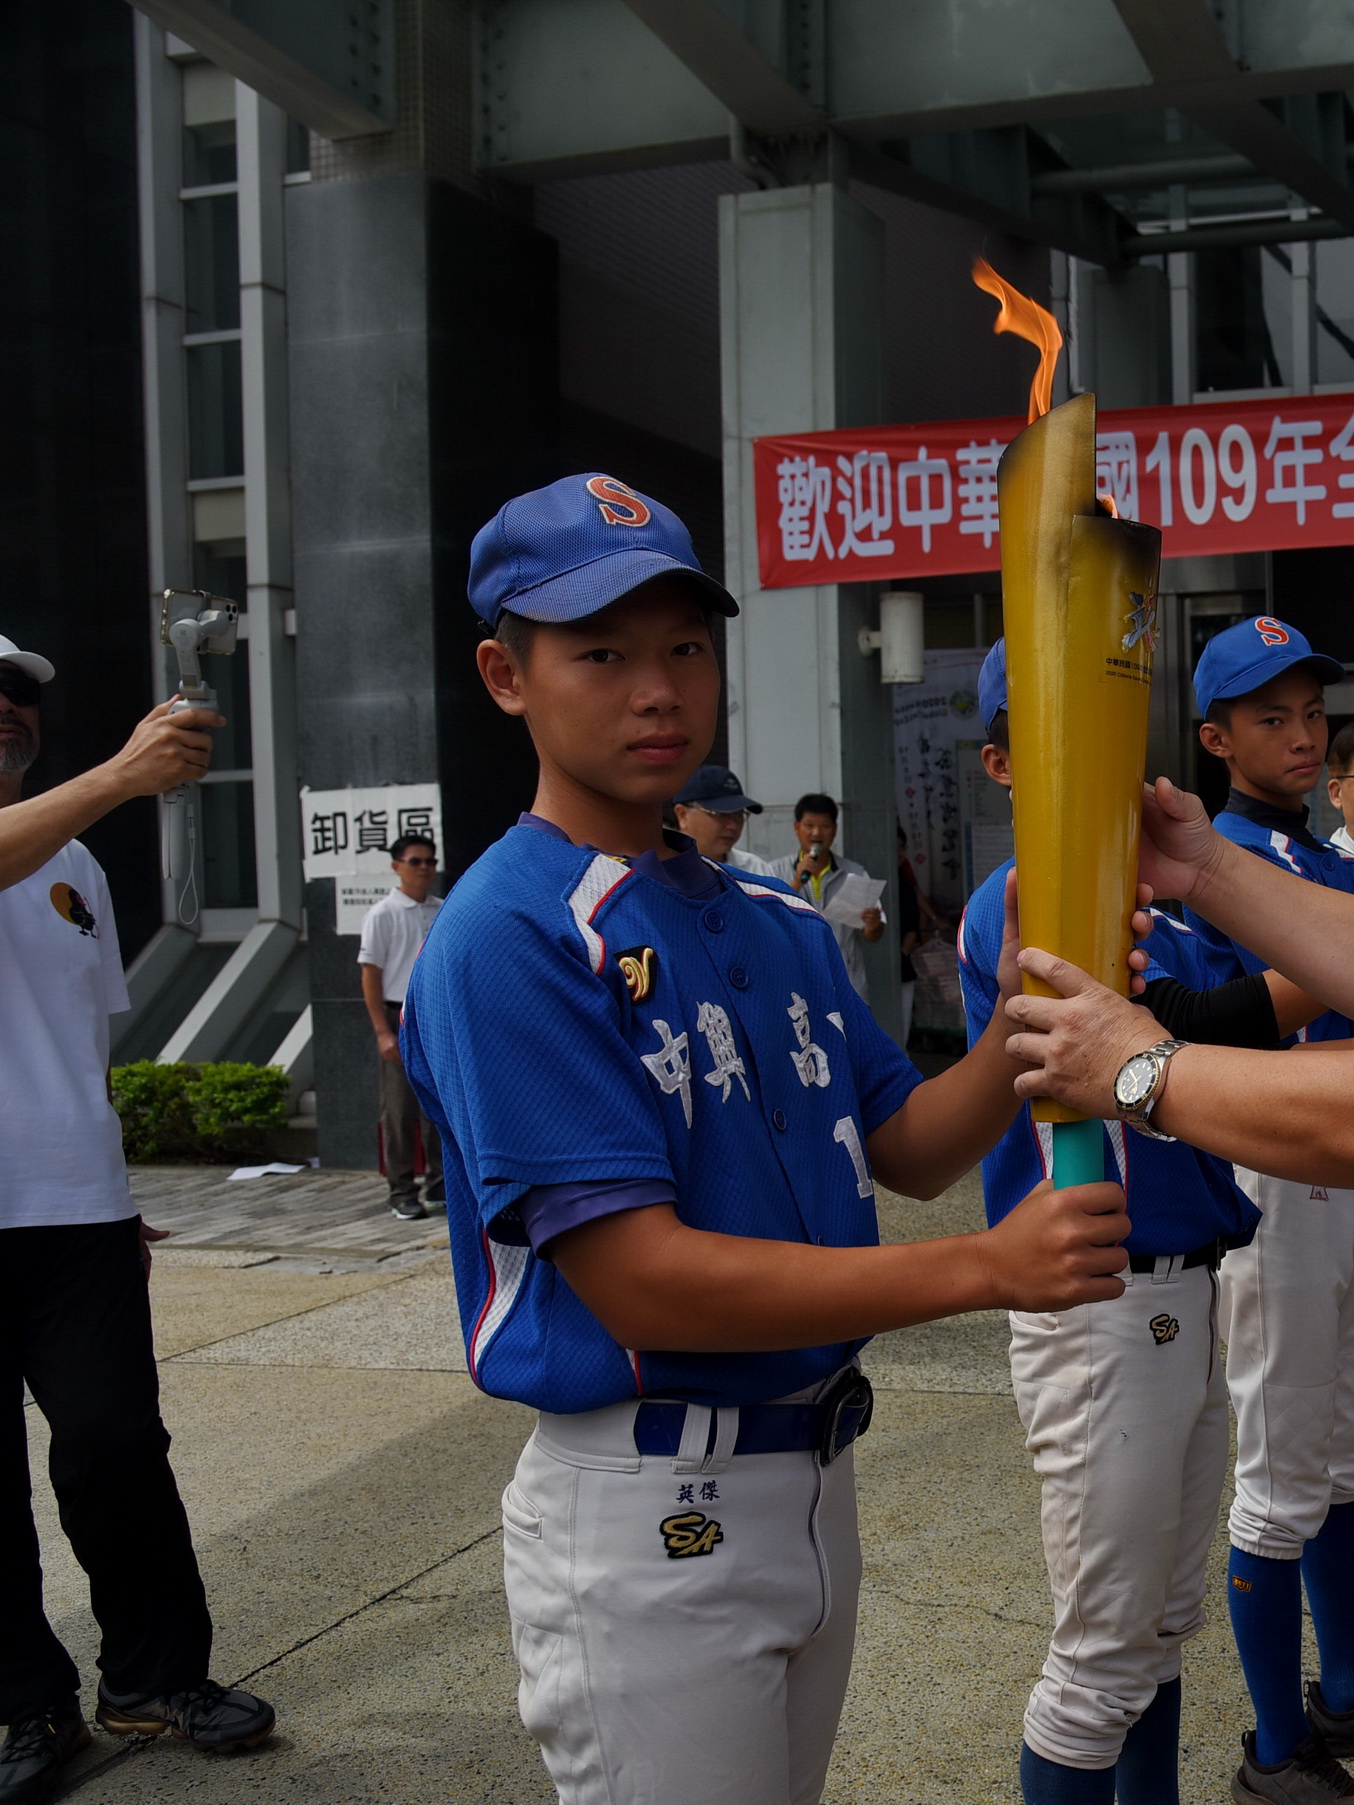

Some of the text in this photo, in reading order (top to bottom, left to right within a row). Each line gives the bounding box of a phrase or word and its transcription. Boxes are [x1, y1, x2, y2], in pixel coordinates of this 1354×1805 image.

[587, 477, 651, 527] S
[1255, 617, 1289, 646] S
[311, 807, 435, 855] 卸貨區
[640, 992, 848, 1130] 中興高
[676, 1480, 720, 1503] 英傑
